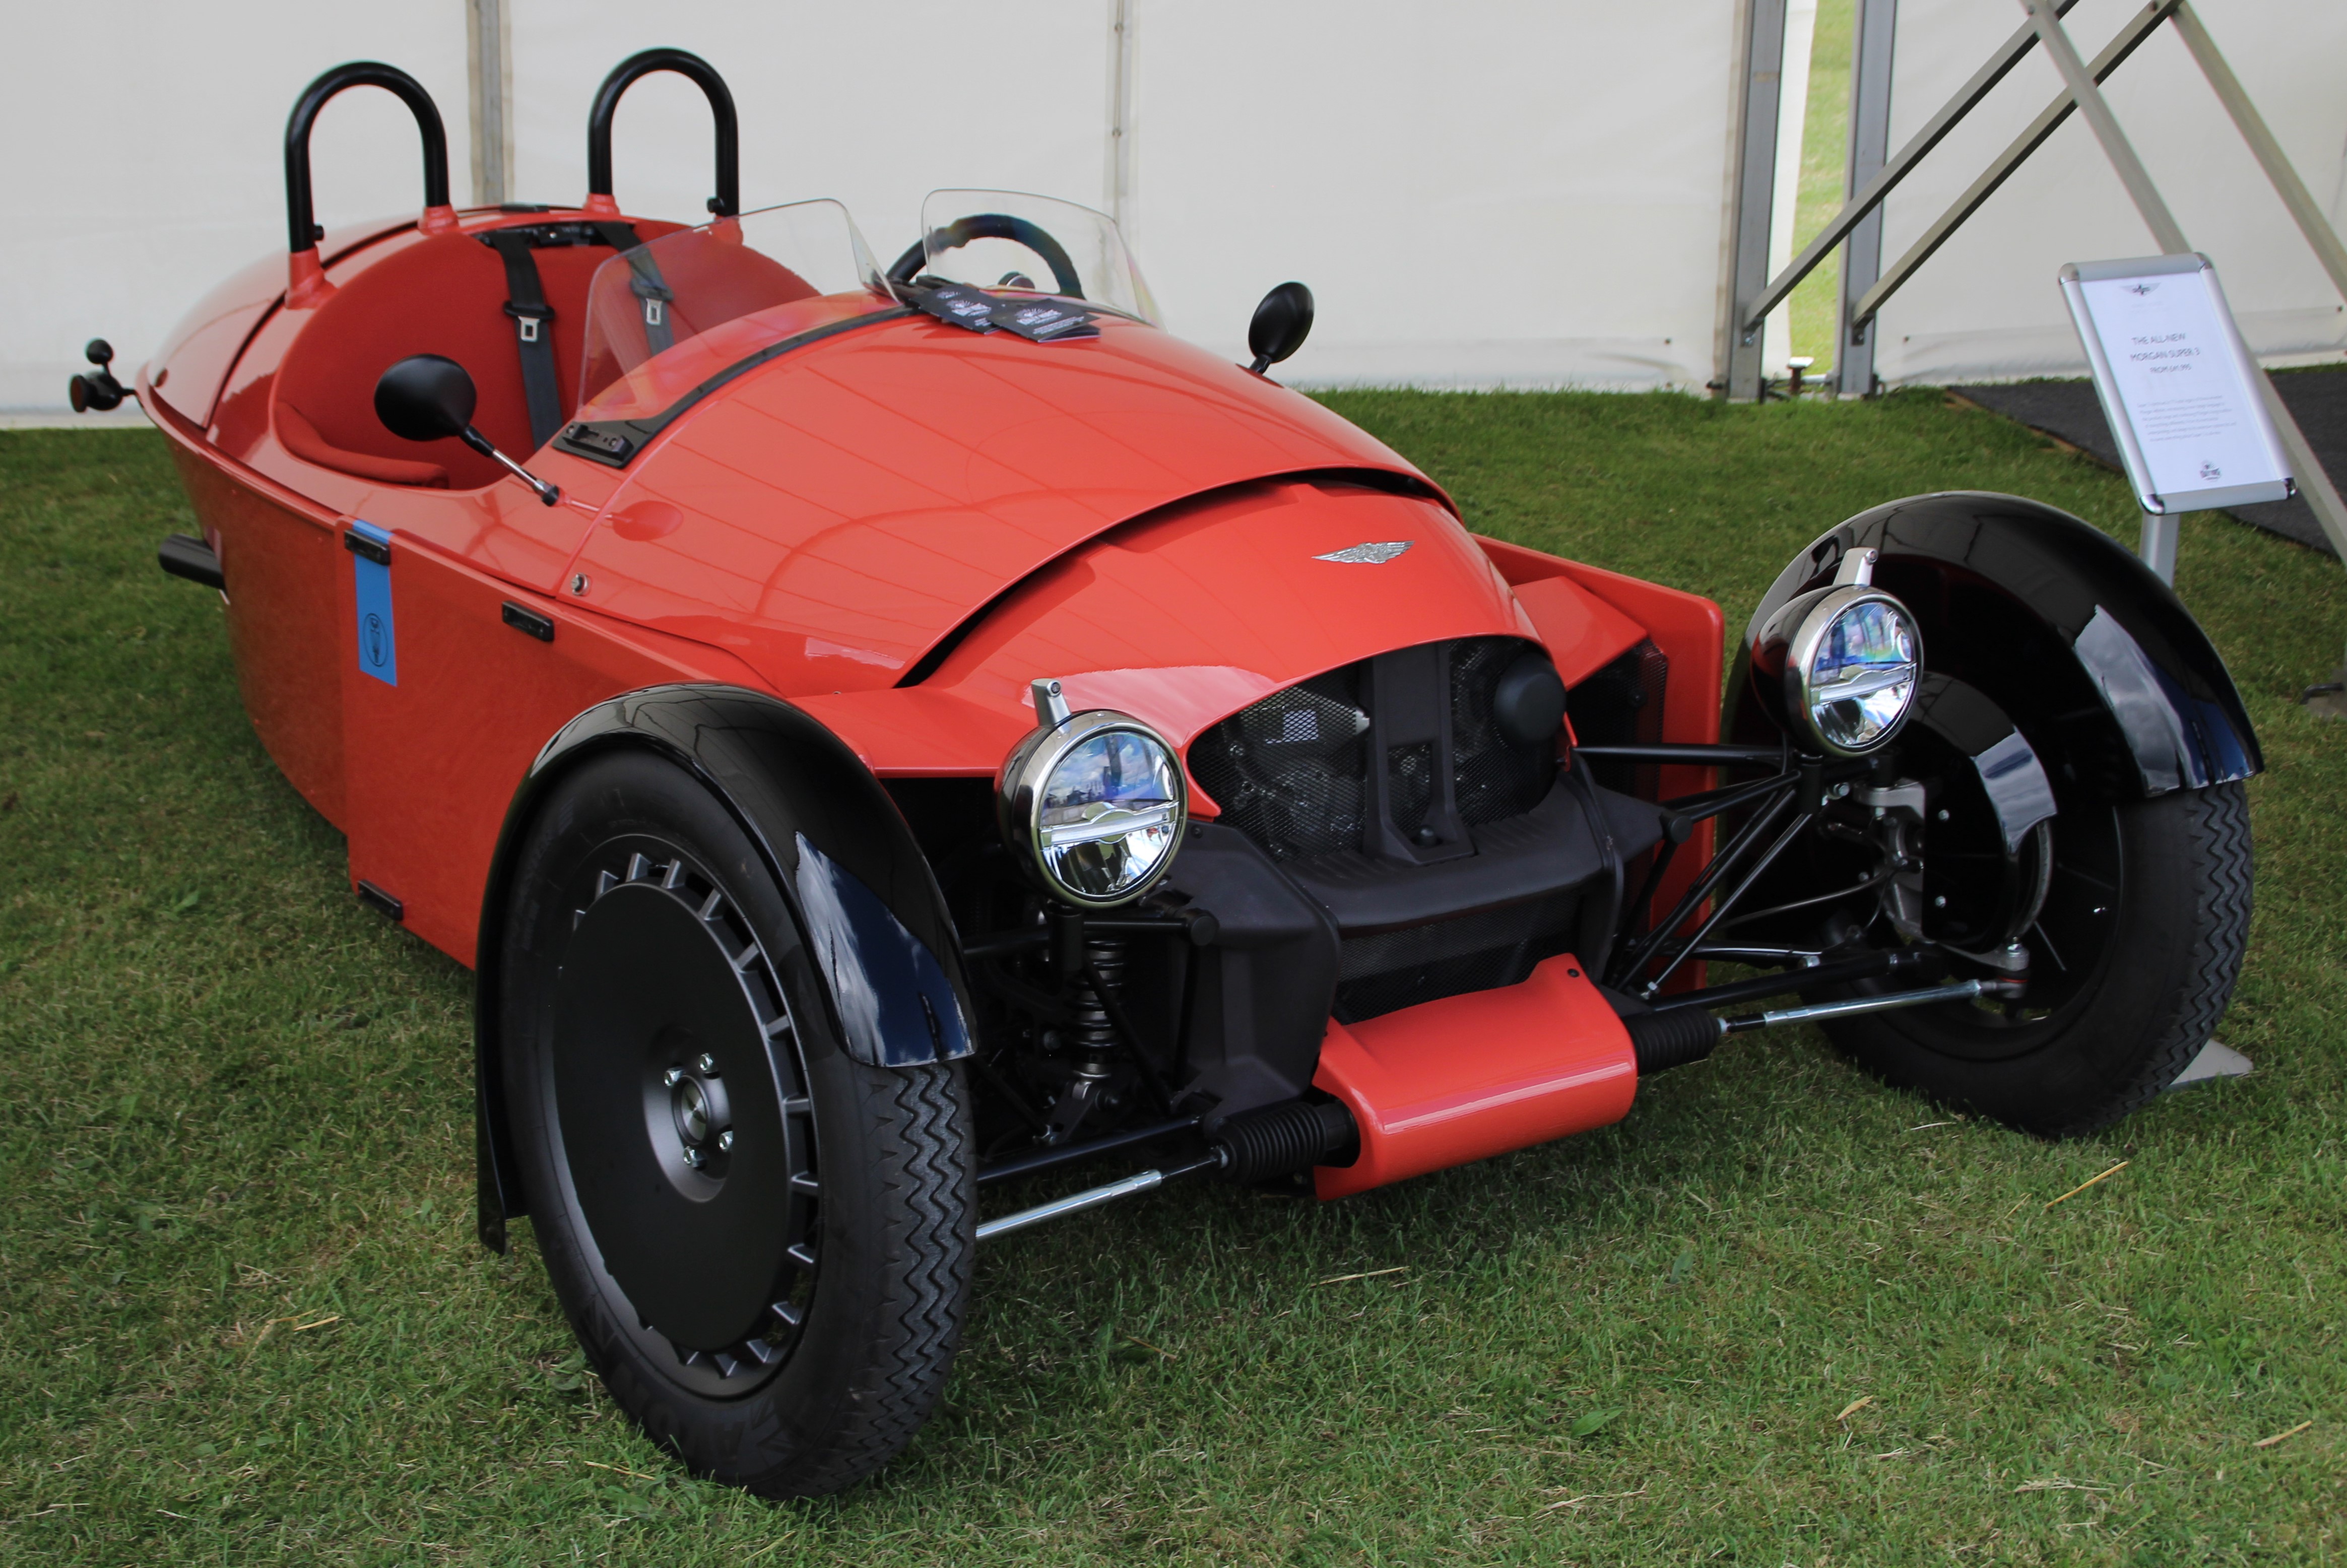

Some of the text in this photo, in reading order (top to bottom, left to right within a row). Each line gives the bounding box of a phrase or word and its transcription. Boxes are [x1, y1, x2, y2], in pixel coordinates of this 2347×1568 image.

[2131, 336, 2149, 345] THE
[2130, 347, 2200, 361] MORGAN SUPER 3
